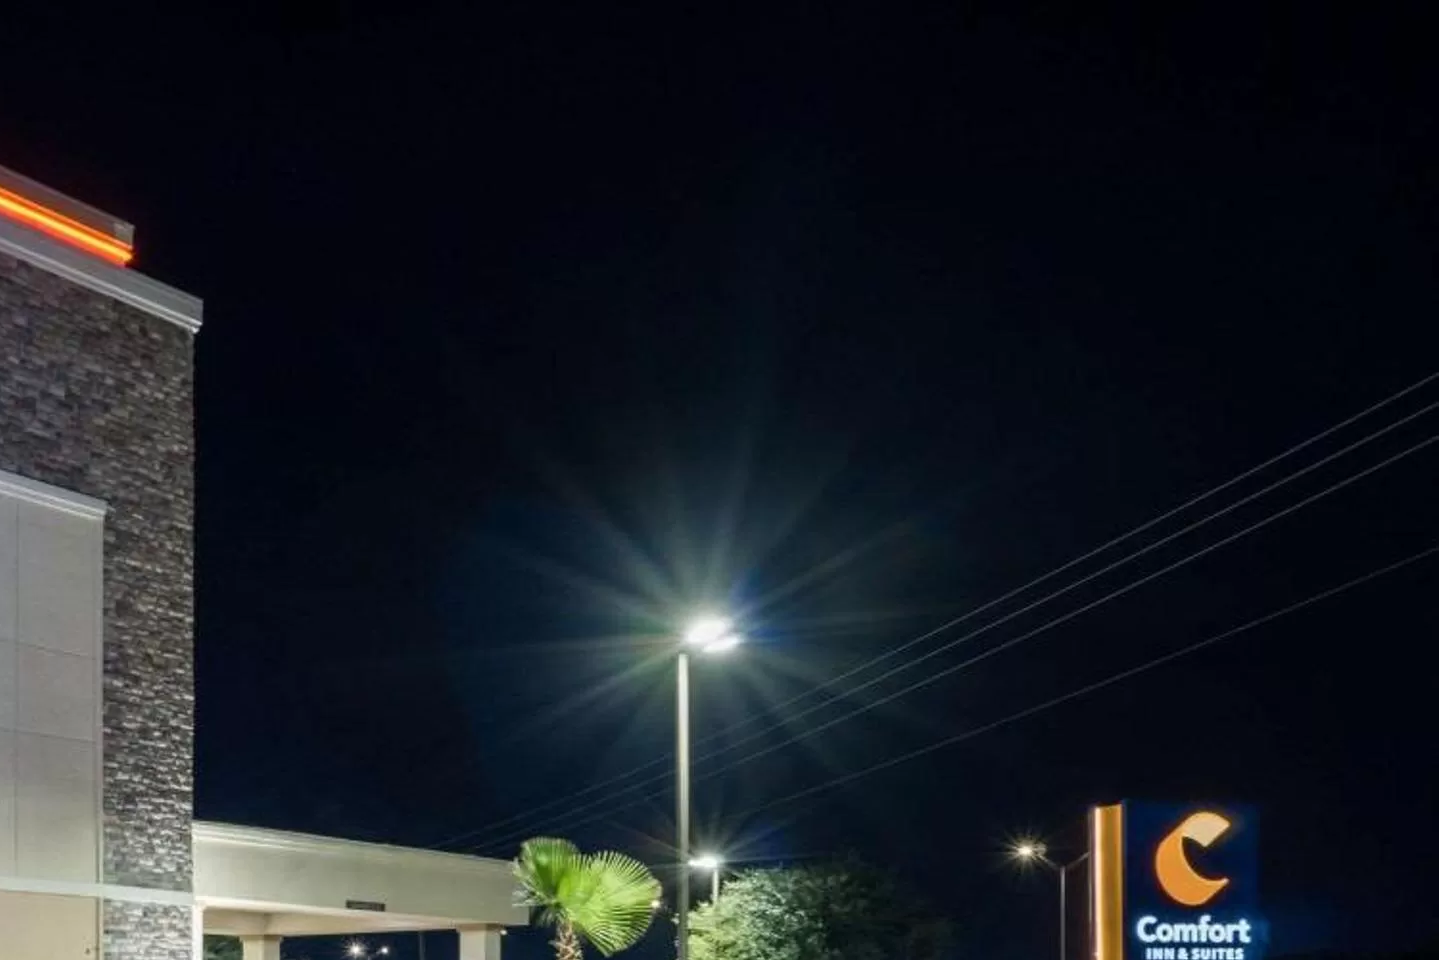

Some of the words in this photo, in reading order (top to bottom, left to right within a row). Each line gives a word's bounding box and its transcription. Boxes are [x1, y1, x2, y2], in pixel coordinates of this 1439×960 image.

[1136, 914, 1252, 943] Comfort
[1146, 947, 1175, 960] INN
[1177, 947, 1189, 960] &
[1191, 947, 1244, 960] SUITES
